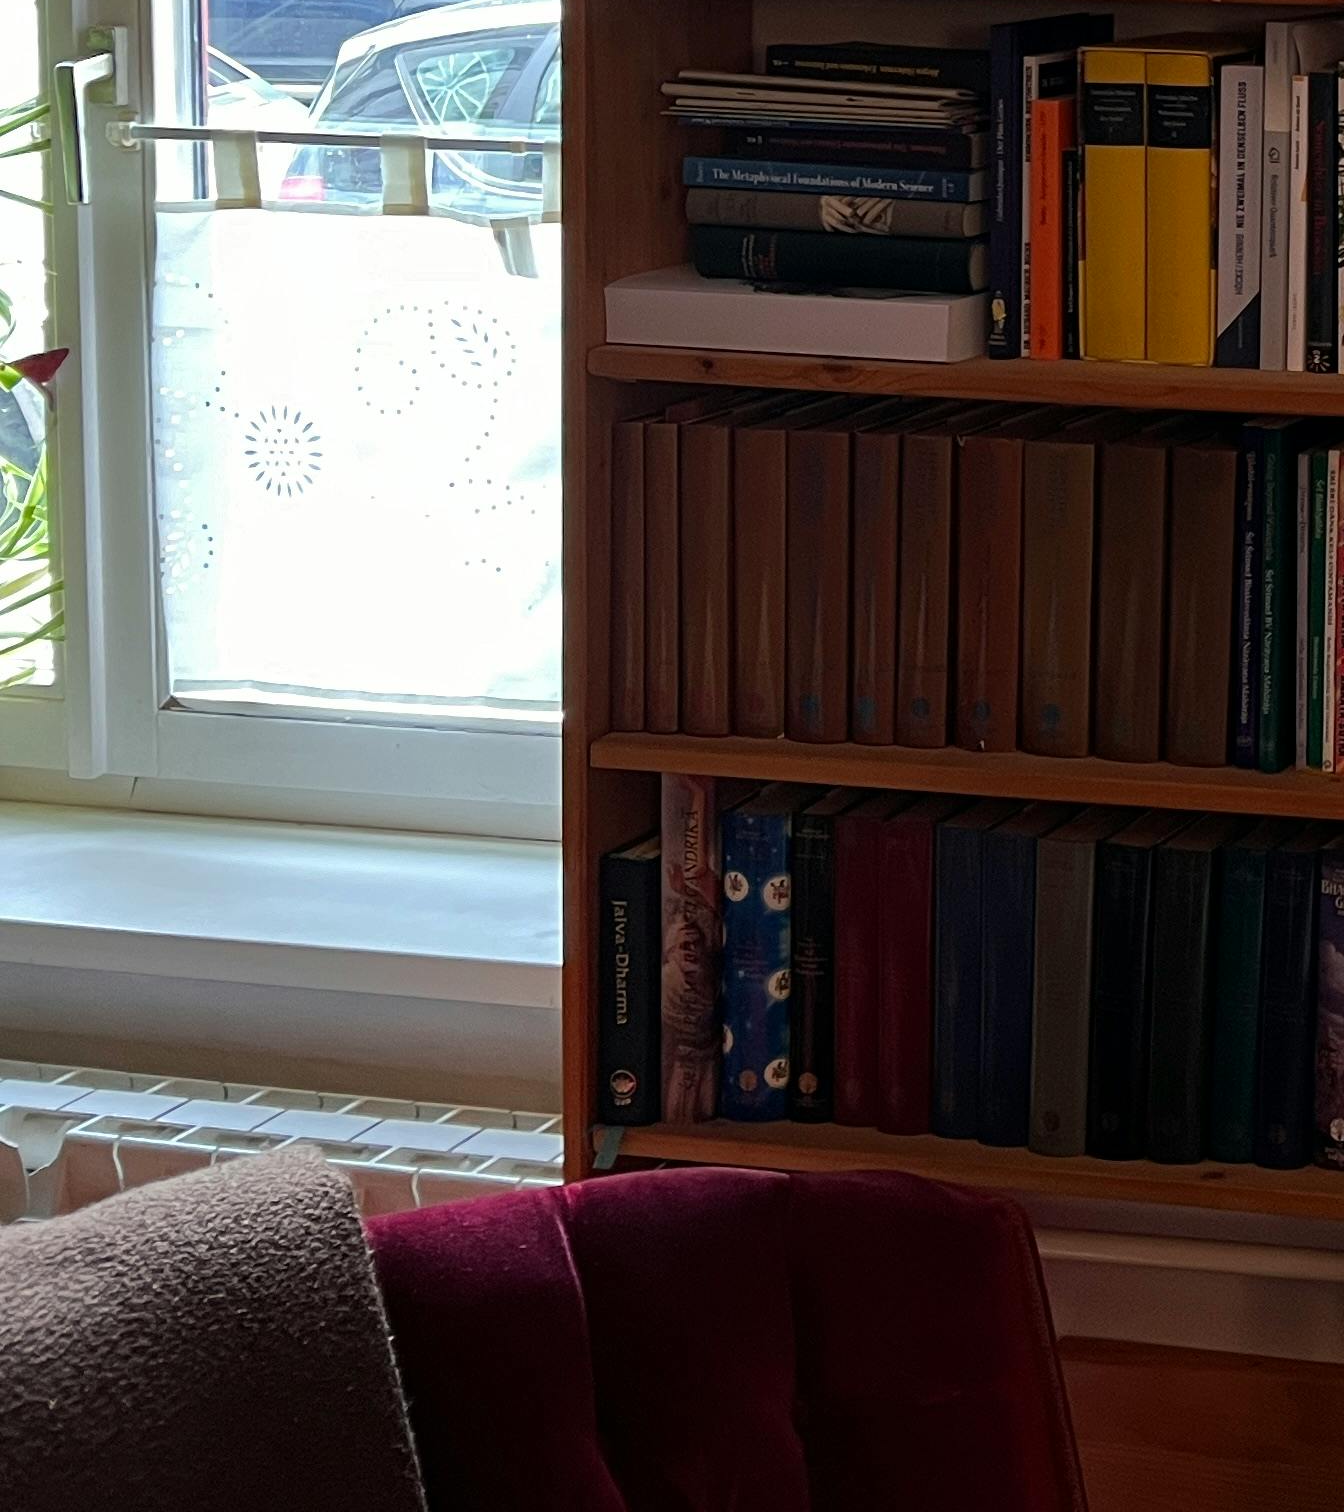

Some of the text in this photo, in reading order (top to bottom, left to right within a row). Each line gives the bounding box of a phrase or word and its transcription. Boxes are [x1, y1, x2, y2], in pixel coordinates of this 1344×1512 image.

[712, 168, 728, 180] The
[732, 170, 790, 187] Metaphysical
[793, 173, 848, 188] Foundations
[851, 175, 860, 188] of
[862, 177, 897, 190] Modern
[1236, 82, 1246, 229] NIE ZWEIMAL IN DENSELBEN FLUSS
[611, 900, 629, 1025] Jaiva-Dharma
